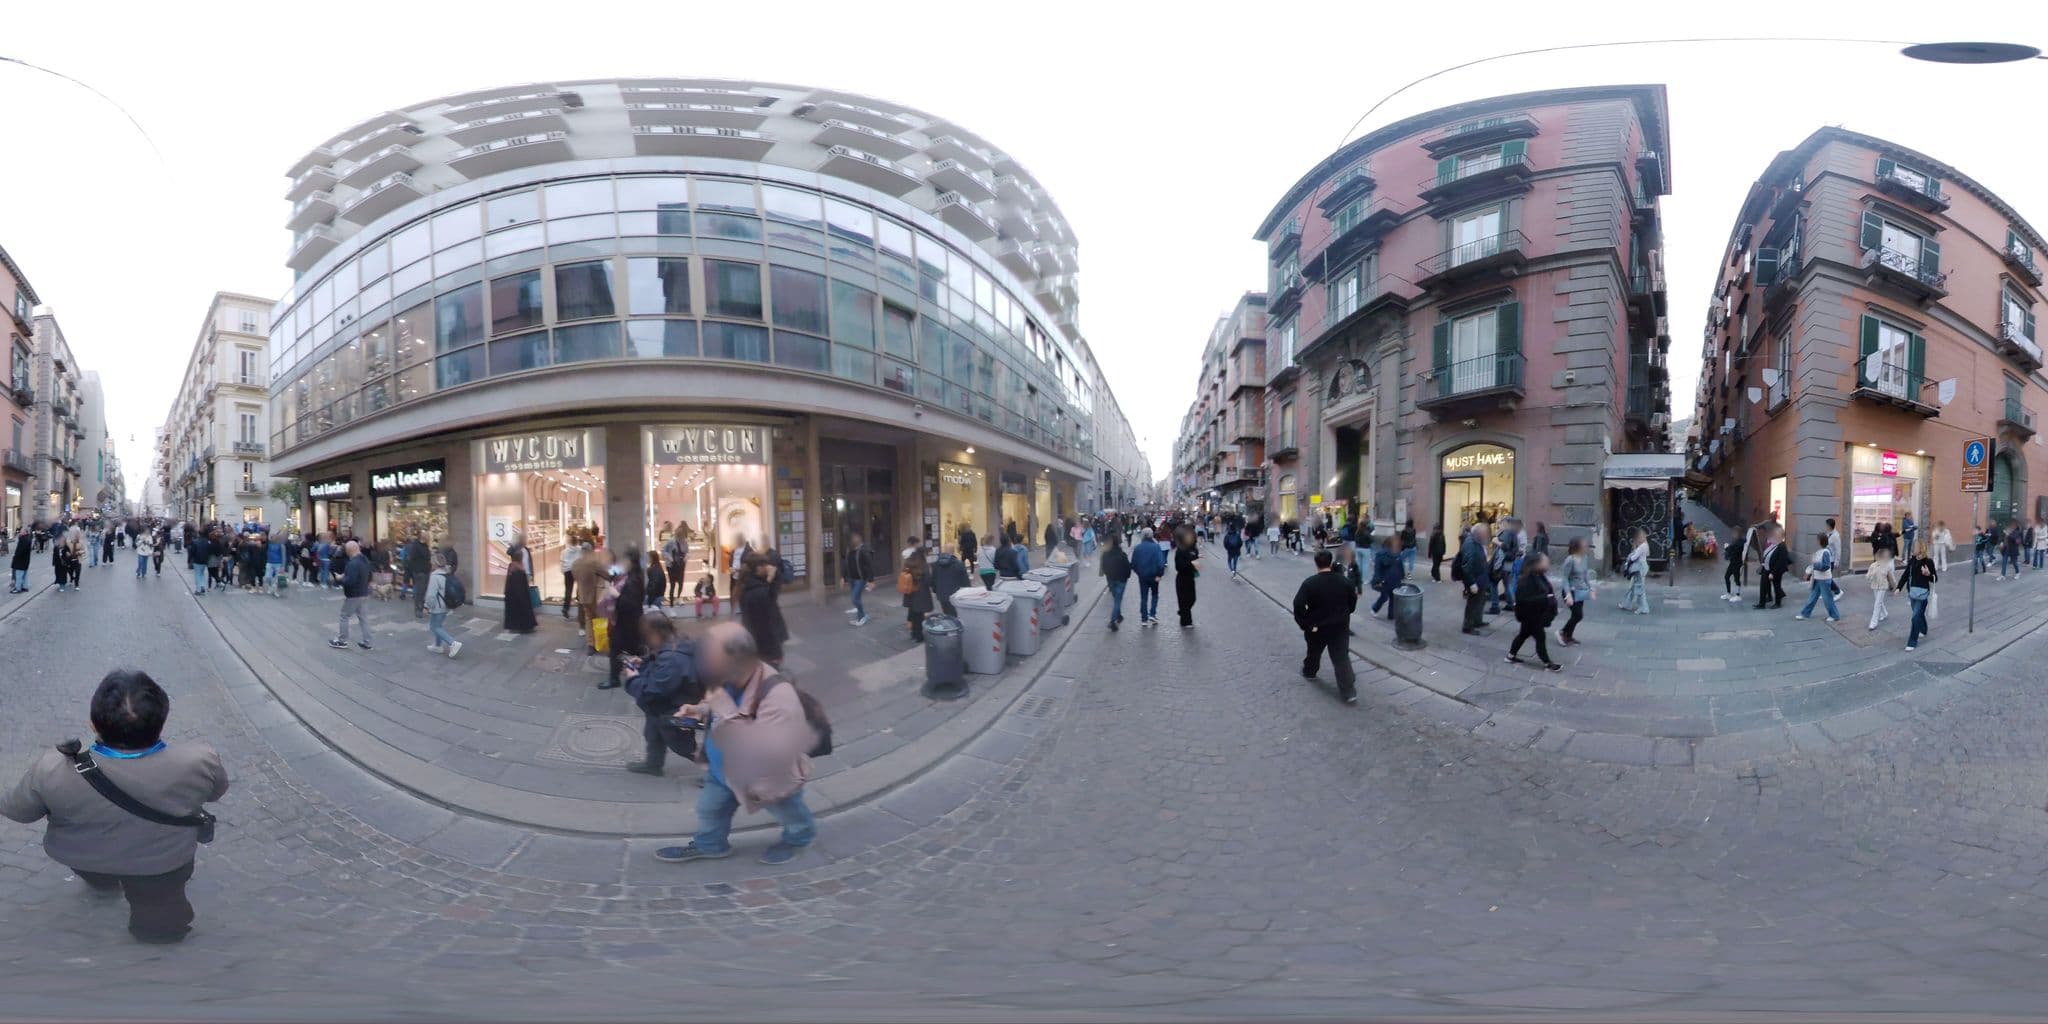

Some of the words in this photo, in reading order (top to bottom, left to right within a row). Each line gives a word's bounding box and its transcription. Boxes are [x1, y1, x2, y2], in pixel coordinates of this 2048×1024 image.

[491, 435, 578, 464] WYCON
[676, 453, 742, 463] cosmetics
[1446, 455, 1475, 471] MUST
[1476, 452, 1506, 466] HAVE
[372, 471, 397, 489] Foot
[397, 468, 442, 486] Locker
[310, 484, 324, 497] Foot
[324, 481, 350, 495] Locker
[495, 522, 505, 538] 3
